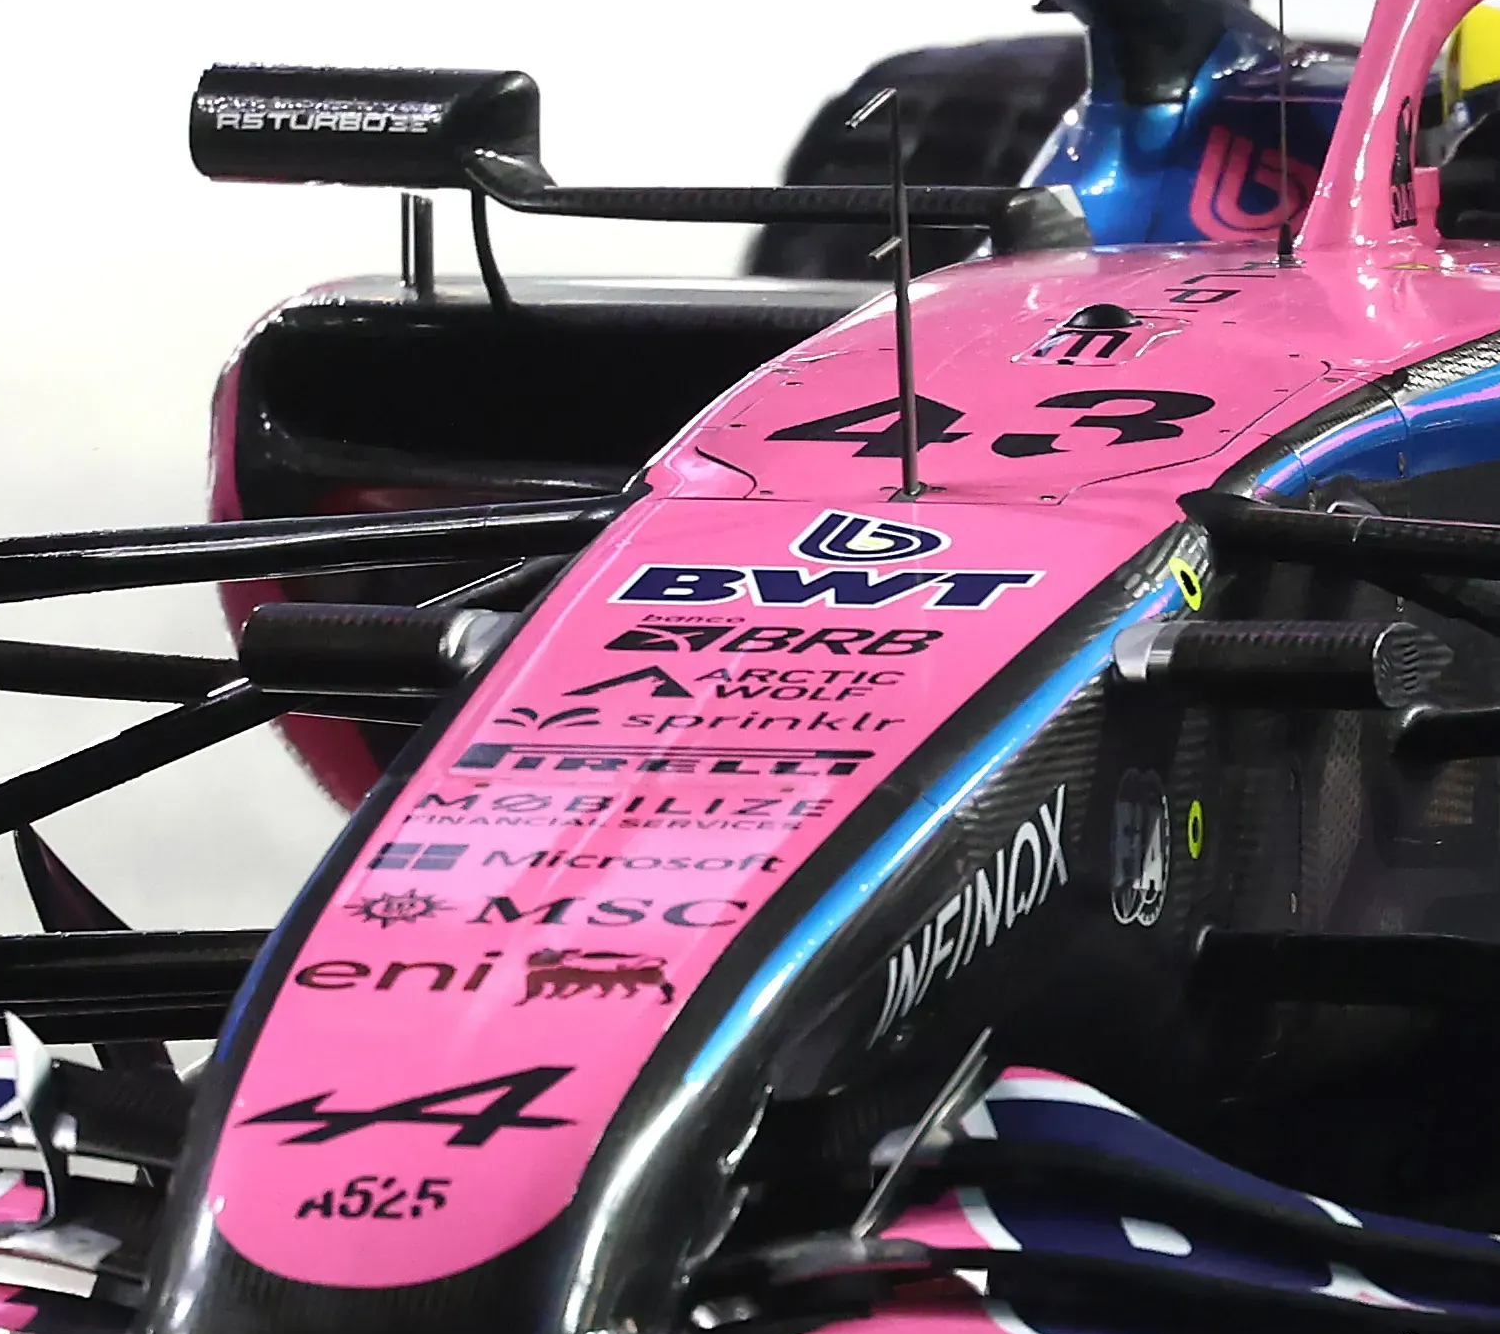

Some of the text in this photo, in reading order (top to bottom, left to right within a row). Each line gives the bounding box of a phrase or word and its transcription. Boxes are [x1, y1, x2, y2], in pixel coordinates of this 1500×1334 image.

[763, 388, 1217, 459] 43
[608, 565, 1046, 611] BWT
[641, 614, 746, 624] banco
[719, 626, 944, 656] BRB
[694, 668, 905, 686] ARCTIC
[714, 685, 874, 701] WOLF
[621, 711, 906, 734] sprinklr
[452, 743, 877, 778] PIRELLI
[401, 814, 805, 831] FINANCIAL SERVICES
[481, 849, 787, 874] Microsoft
[465, 895, 749, 928] MSC
[865, 782, 1070, 1052] INFINOX
[295, 951, 504, 992] eni
